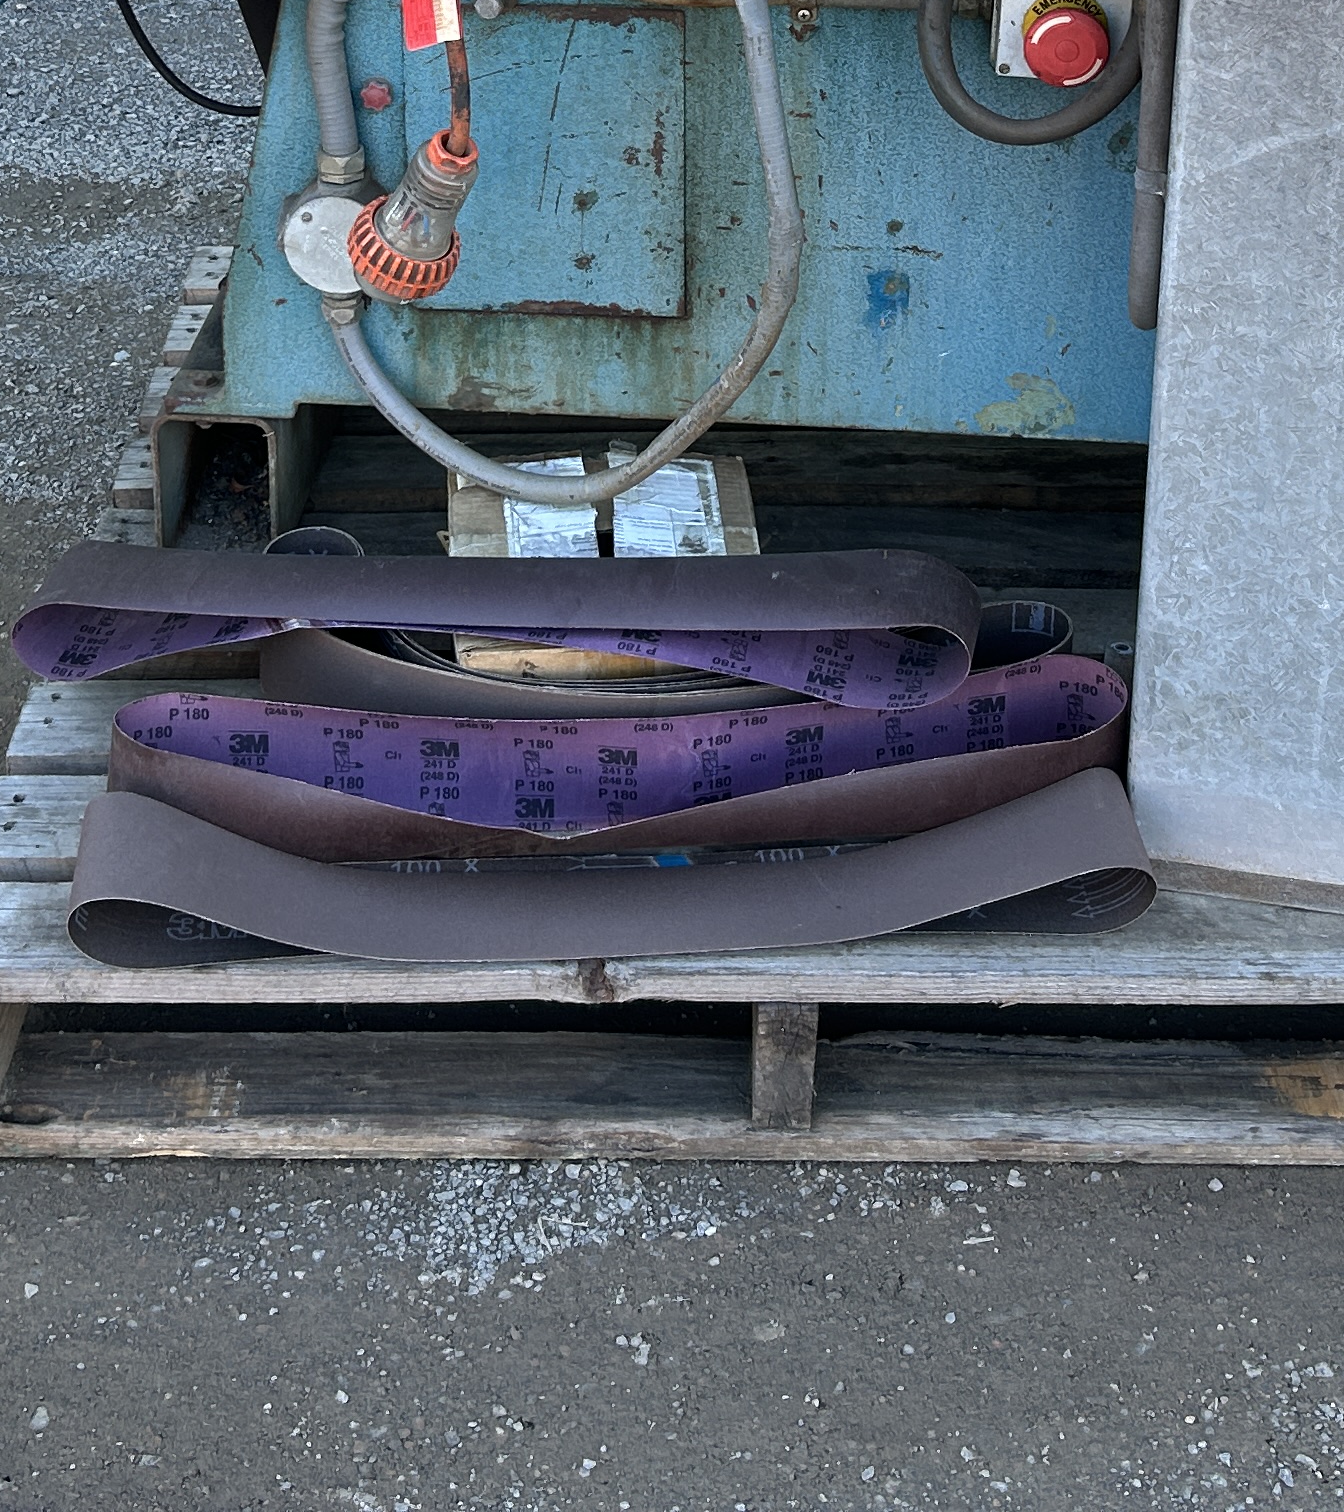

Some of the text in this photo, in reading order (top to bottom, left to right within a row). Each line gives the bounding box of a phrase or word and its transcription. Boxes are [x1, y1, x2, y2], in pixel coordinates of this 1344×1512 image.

[58, 650, 98, 665] 3M
[898, 654, 938, 669] 3M
[806, 670, 847, 689] 3M
[967, 695, 1006, 716] 3M
[169, 708, 210, 721] P 180
[134, 726, 173, 742] P 180
[323, 727, 364, 739] P 180
[785, 725, 824, 746] 3M
[228, 733, 270, 754] 3M
[419, 740, 460, 758] 3M
[514, 738, 554, 750] P 180
[693, 733, 732, 750] P 180
[597, 748, 637, 766] 3M
[876, 744, 914, 760] P 180
[423, 759, 457, 769] 241 D
[601, 766, 634, 776] 241 D
[798, 767, 824, 781] 180
[324, 776, 364, 790] P 180
[515, 780, 555, 792] P 180
[693, 776, 732, 792] P 180
[419, 786, 460, 800] P 180
[598, 788, 637, 801] P 180
[515, 797, 555, 819] 3M
